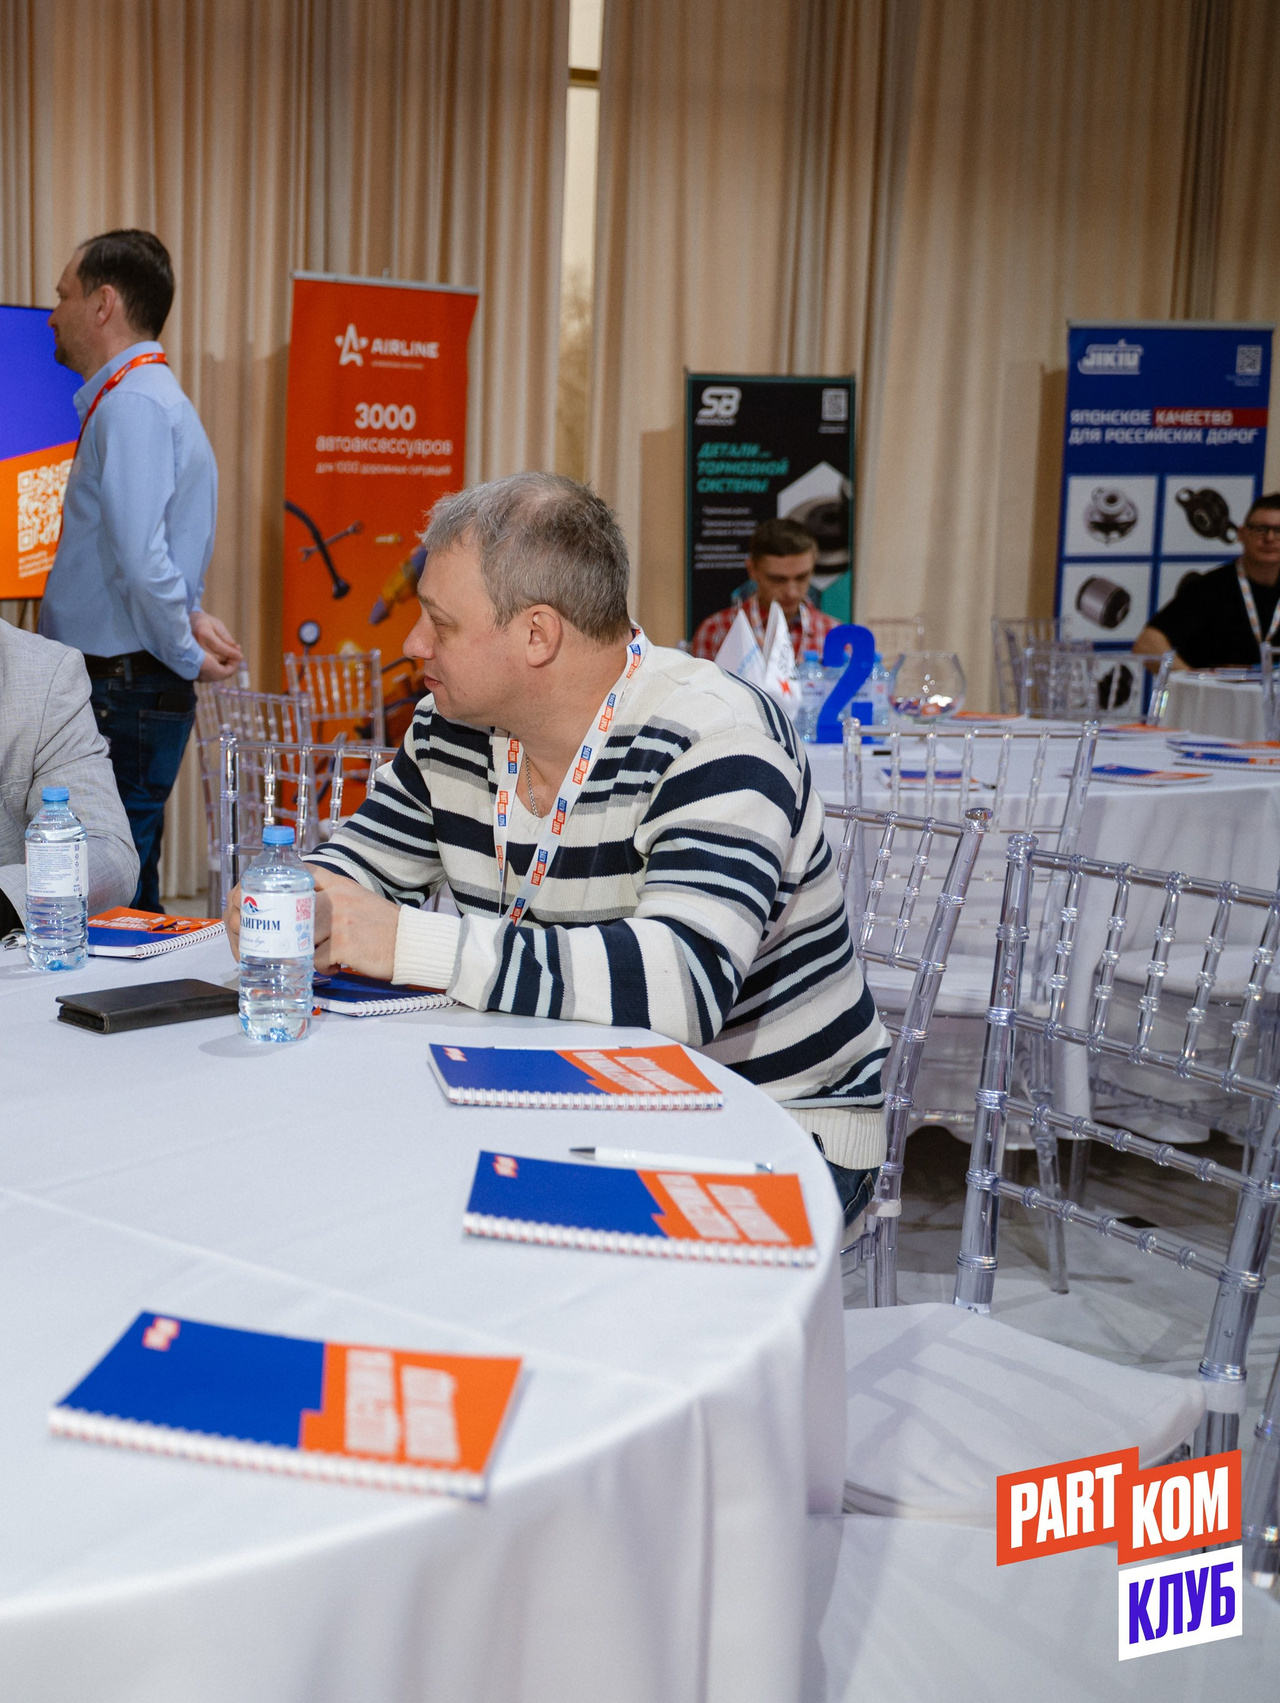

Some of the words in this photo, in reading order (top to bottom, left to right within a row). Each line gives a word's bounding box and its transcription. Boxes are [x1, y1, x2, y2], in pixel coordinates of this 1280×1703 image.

[371, 338, 439, 359] AIRLINE
[355, 402, 416, 431] 3000
[1070, 409, 1151, 426] ЯПОНСКОЕ
[1155, 409, 1234, 426] КАЧЕСТВО
[1069, 428, 1102, 445] ДЛЯ
[1105, 426, 1204, 444] РОССИЙСКИХ
[1205, 429, 1259, 445] ДОРОГ
[817, 624, 875, 743] 2
[240, 915, 280, 931] ЛИГРИМ
